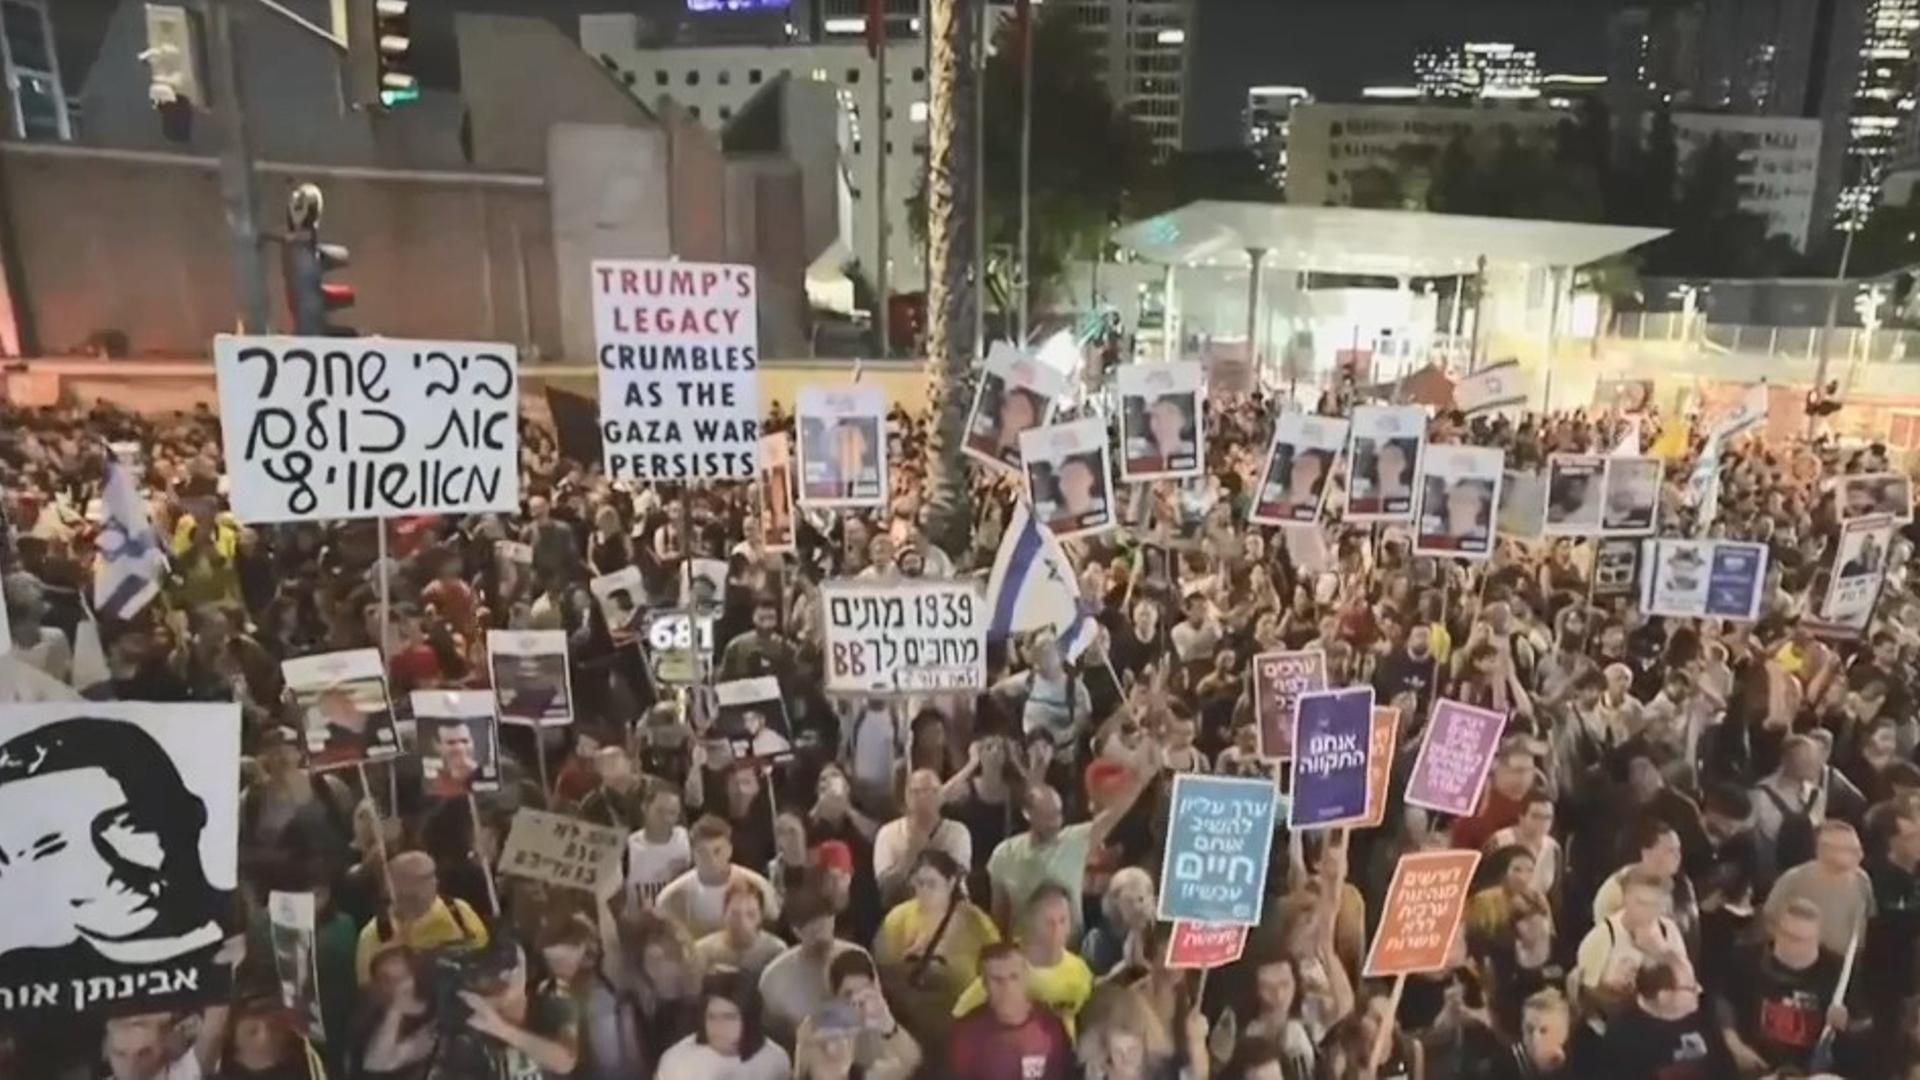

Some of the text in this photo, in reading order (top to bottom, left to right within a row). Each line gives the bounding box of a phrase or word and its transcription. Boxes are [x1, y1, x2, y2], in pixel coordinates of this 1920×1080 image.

[596, 268, 752, 298] TRUMP'S
[613, 307, 741, 334] LEGACY
[600, 344, 757, 371] CRUMBLES
[237, 347, 513, 402] ביבי שחרר
[624, 382, 735, 407] AS THE
[244, 399, 510, 462] את כולם
[604, 420, 757, 443] GAZA WAR
[610, 453, 754, 478] PERSISTS
[831, 593, 974, 630] 1939 מתים
[650, 615, 713, 650] 681
[1299, 748, 1365, 778] התקווה
[1179, 797, 1269, 818] ערך עליון
[1176, 851, 1255, 885] חיים
[72, 967, 199, 1011] אבינתן
